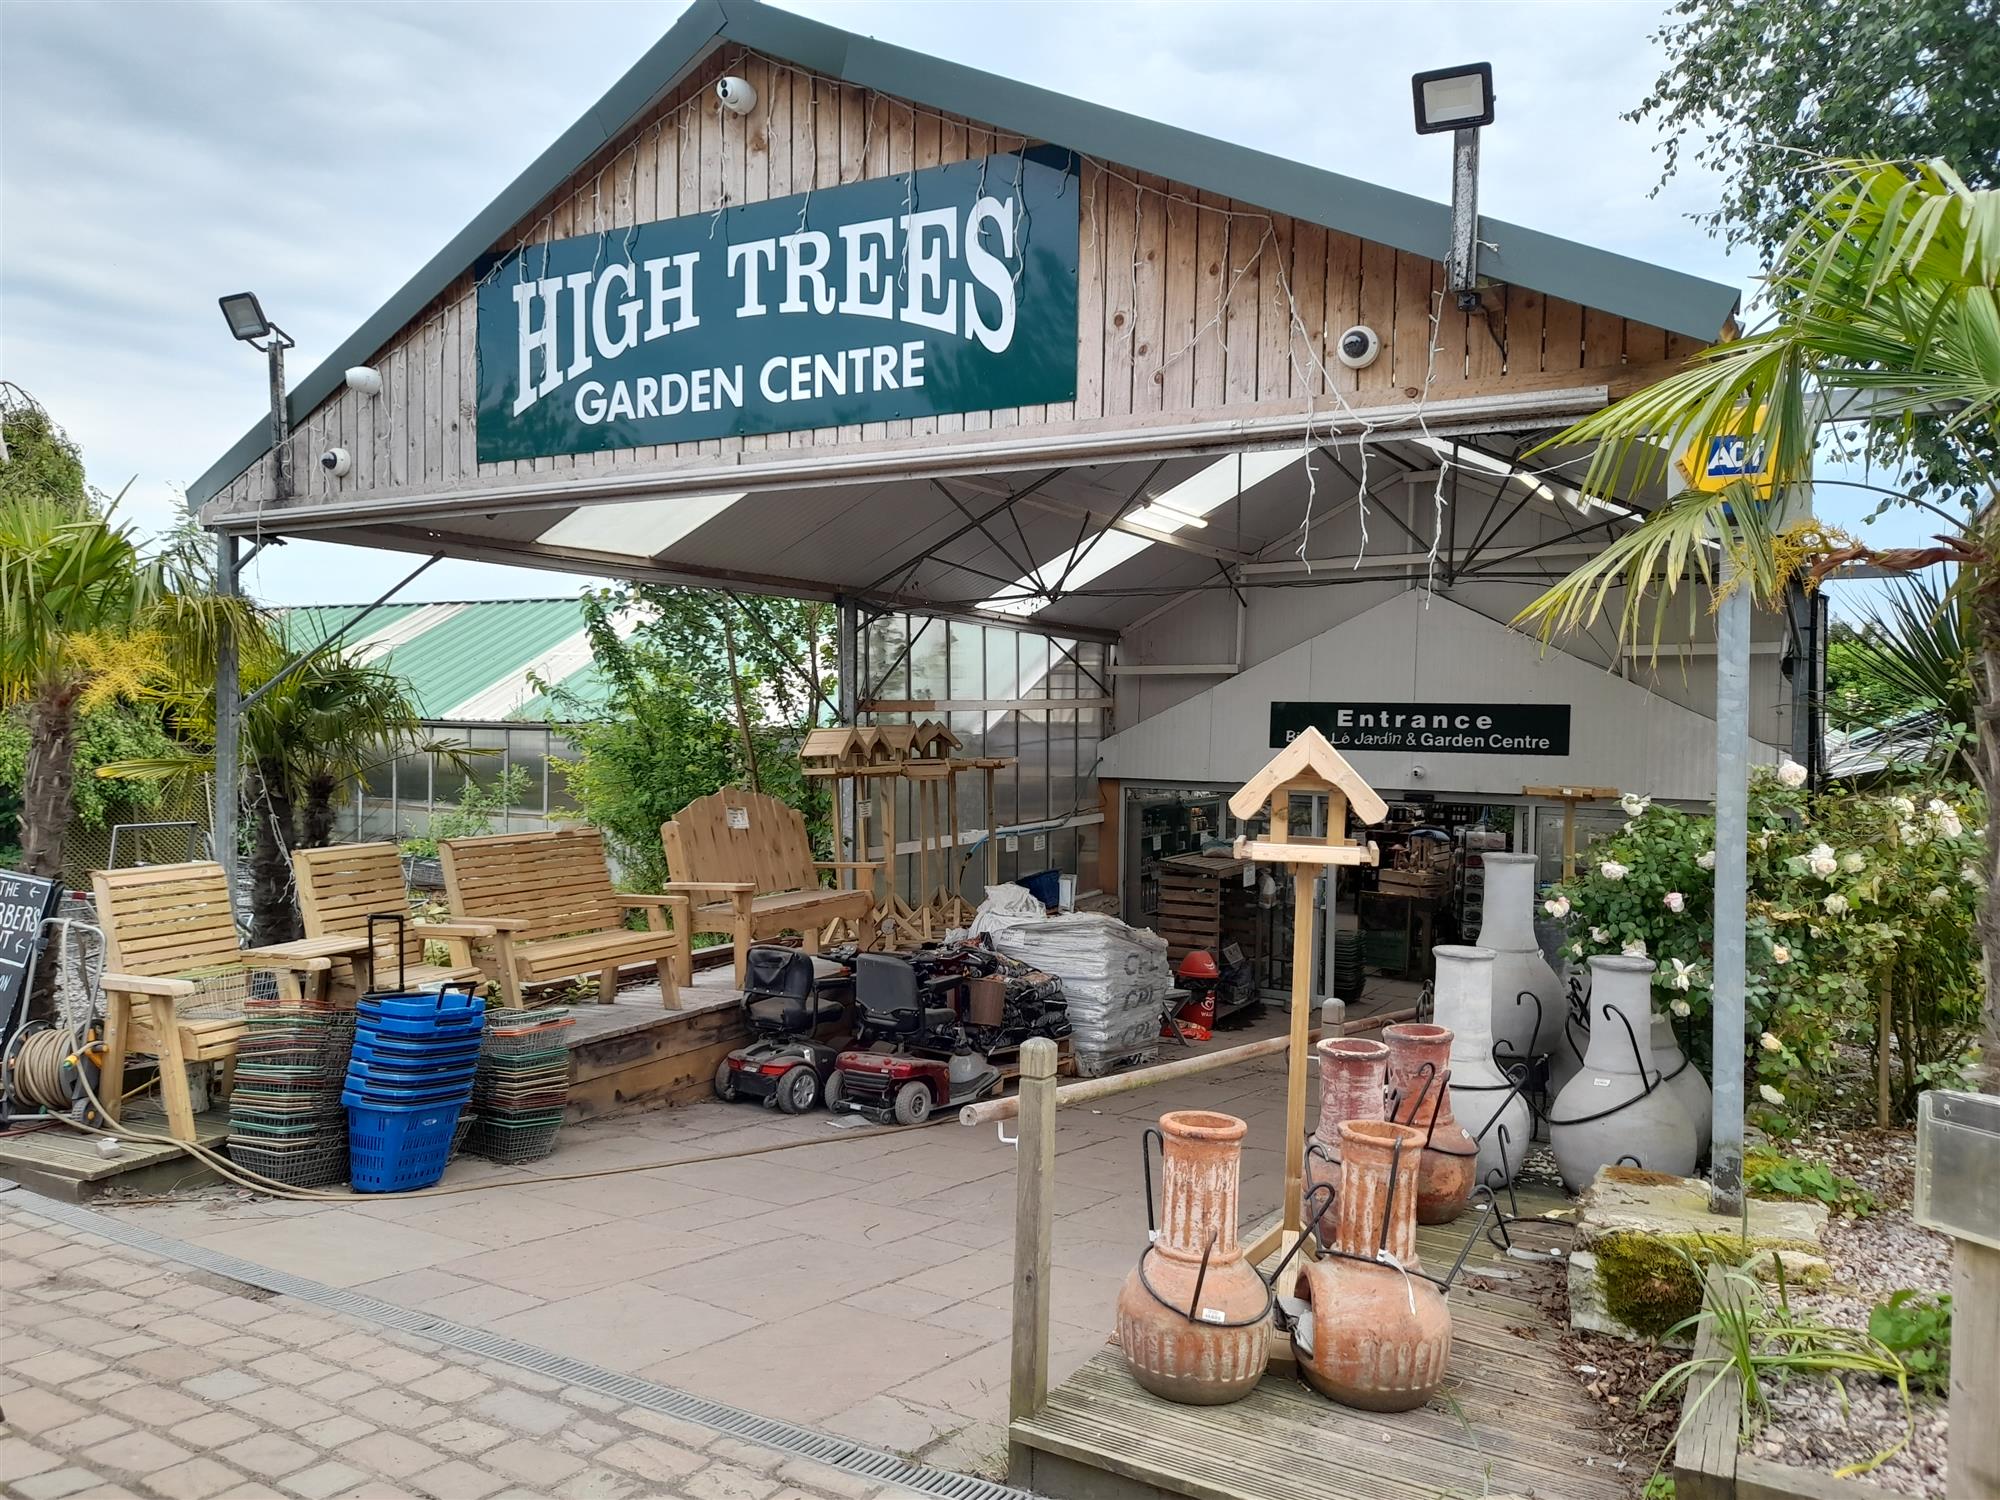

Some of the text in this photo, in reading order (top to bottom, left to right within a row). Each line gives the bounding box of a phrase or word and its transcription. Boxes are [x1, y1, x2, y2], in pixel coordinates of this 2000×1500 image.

[513, 196, 1017, 417] HIGH TREES
[574, 340, 925, 425] GARDEN CENTRE
[1337, 709, 1493, 730] Entrance
[1354, 731, 1402, 745] Jardin
[1406, 732, 1417, 746] &
[1420, 733, 1485, 748] Garden
[1489, 734, 1550, 749] Centre
